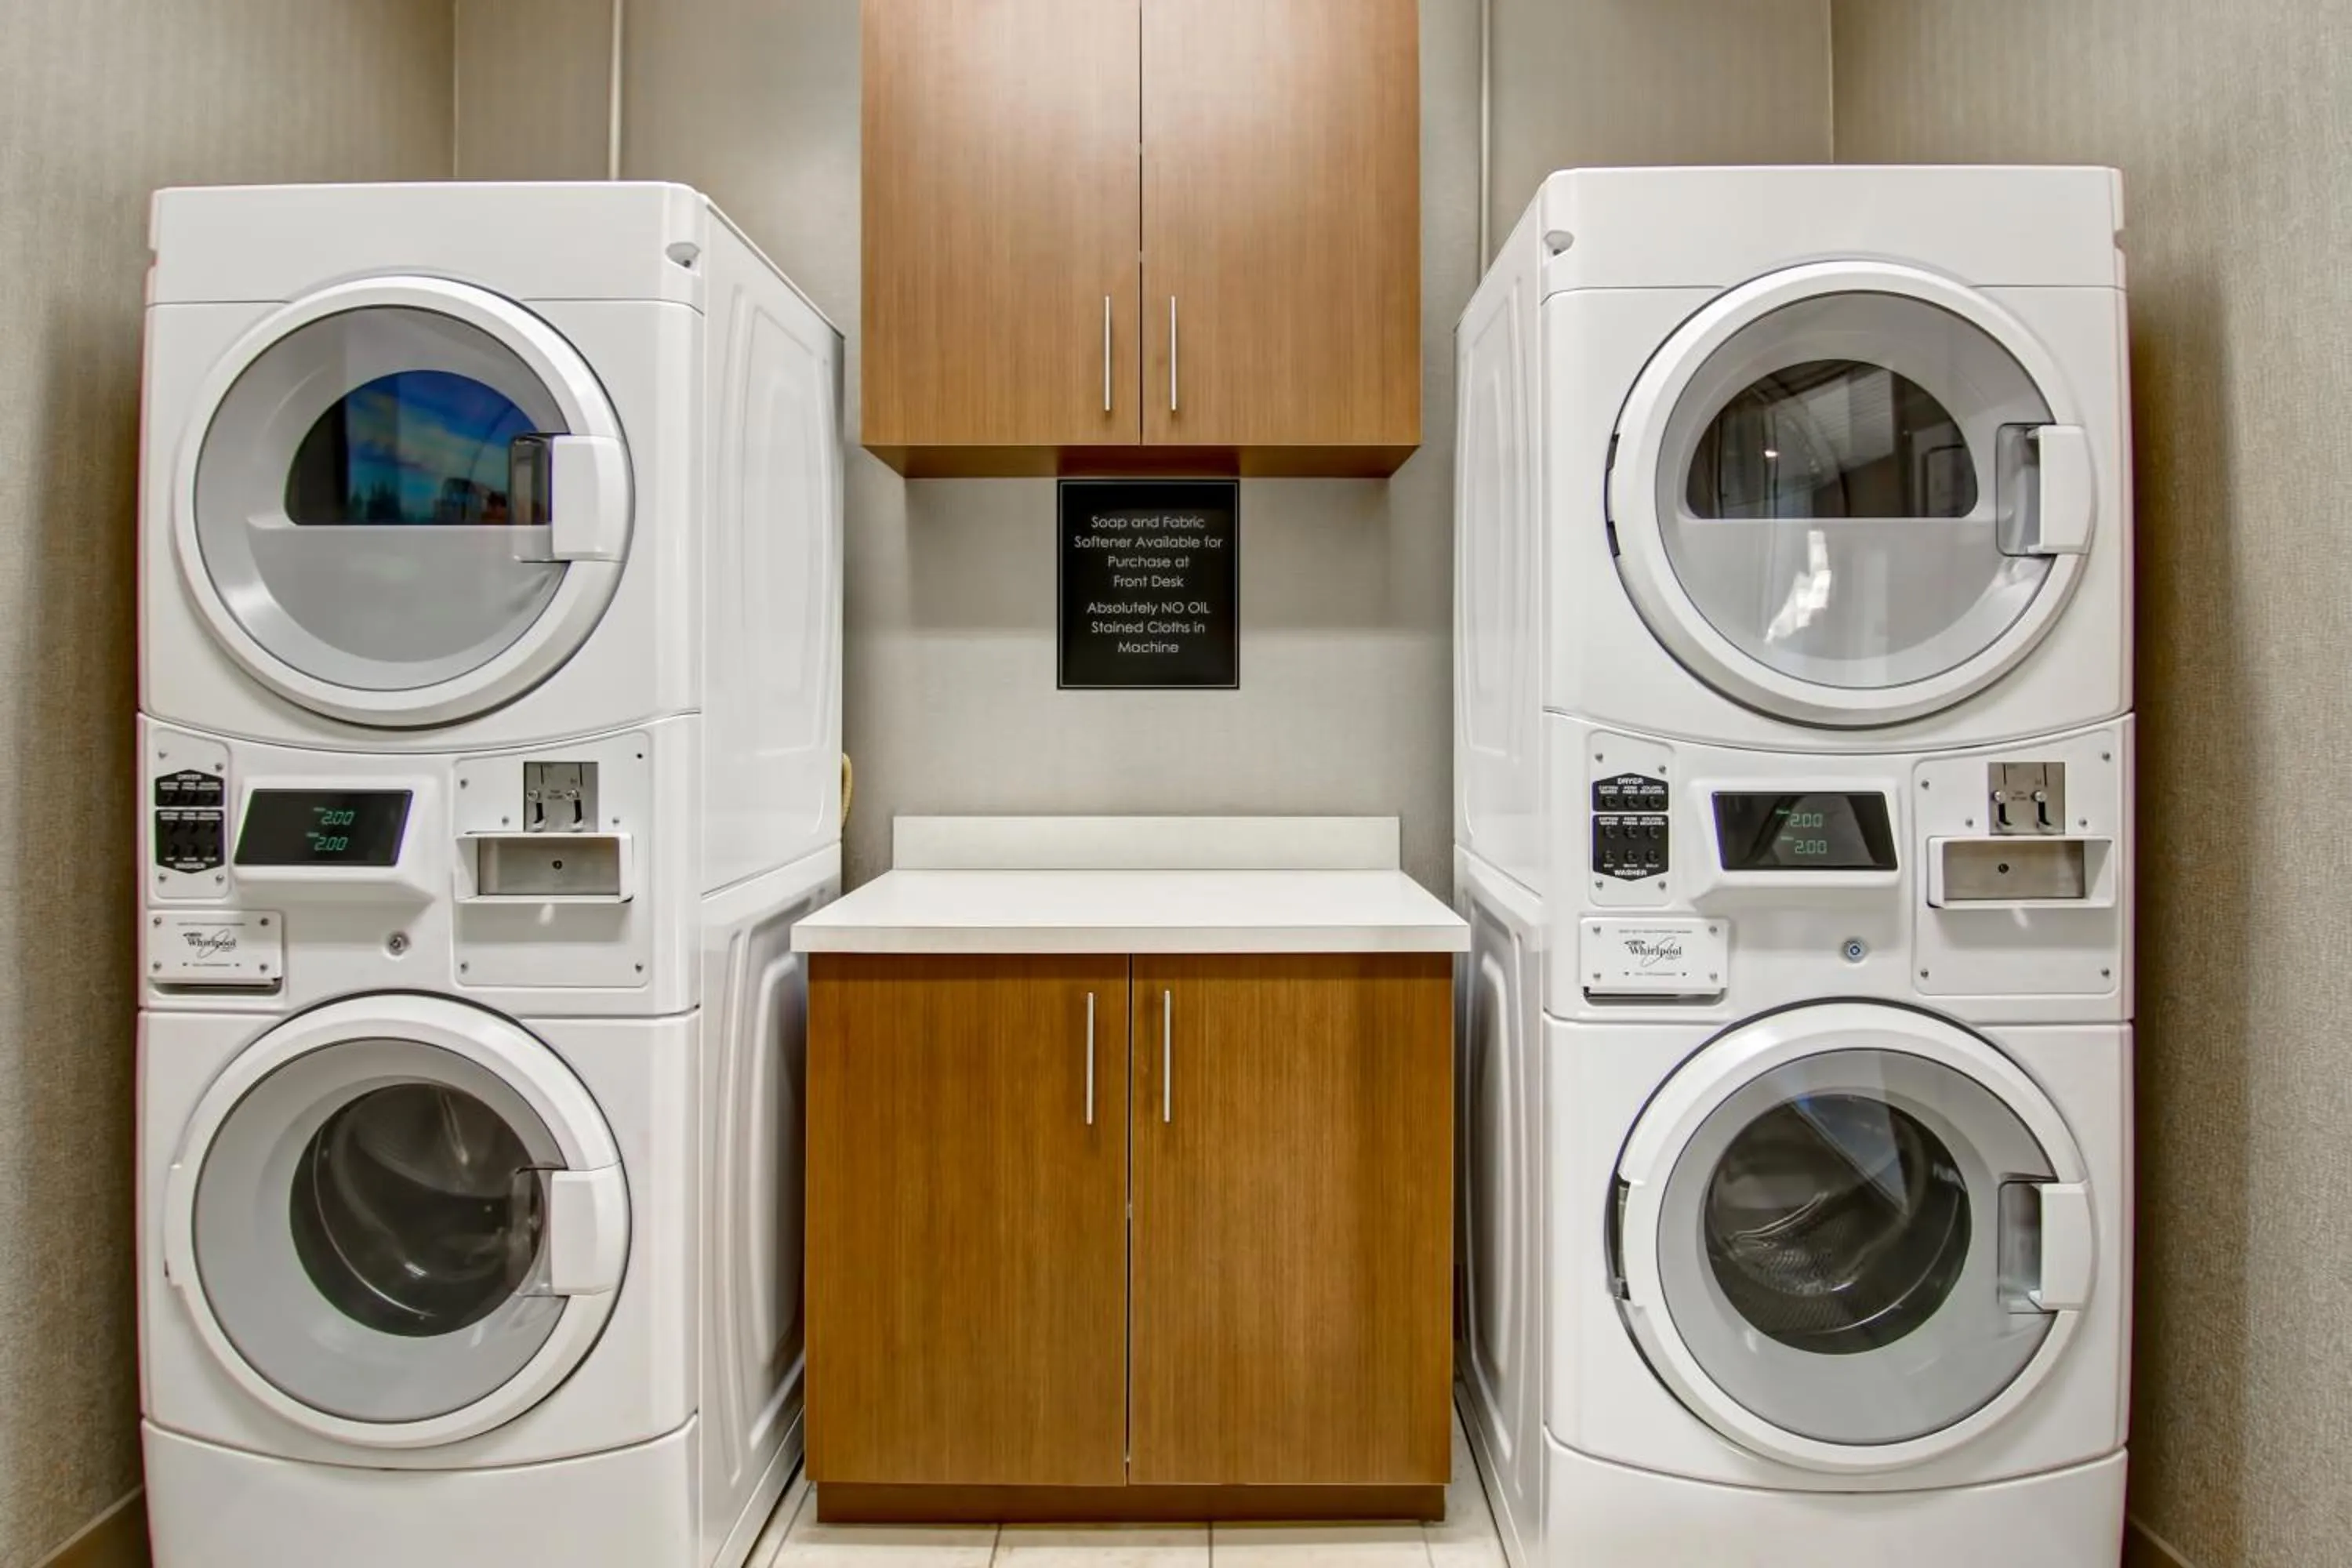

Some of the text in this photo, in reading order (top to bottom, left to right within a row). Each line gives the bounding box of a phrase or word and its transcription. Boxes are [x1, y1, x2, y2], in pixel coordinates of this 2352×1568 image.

[1091, 515, 1205, 530] Soap and Fabric
[1073, 535, 1223, 548] Softener Available for
[1107, 555, 1189, 568] Purchase at
[1113, 575, 1185, 588] Front Desk
[1086, 601, 1210, 615] Absolutely NO OIL
[1091, 620, 1206, 633] Stained Cloths in
[1117, 641, 1180, 653] Machine
[1628, 946, 1682, 958] Whirlpool
